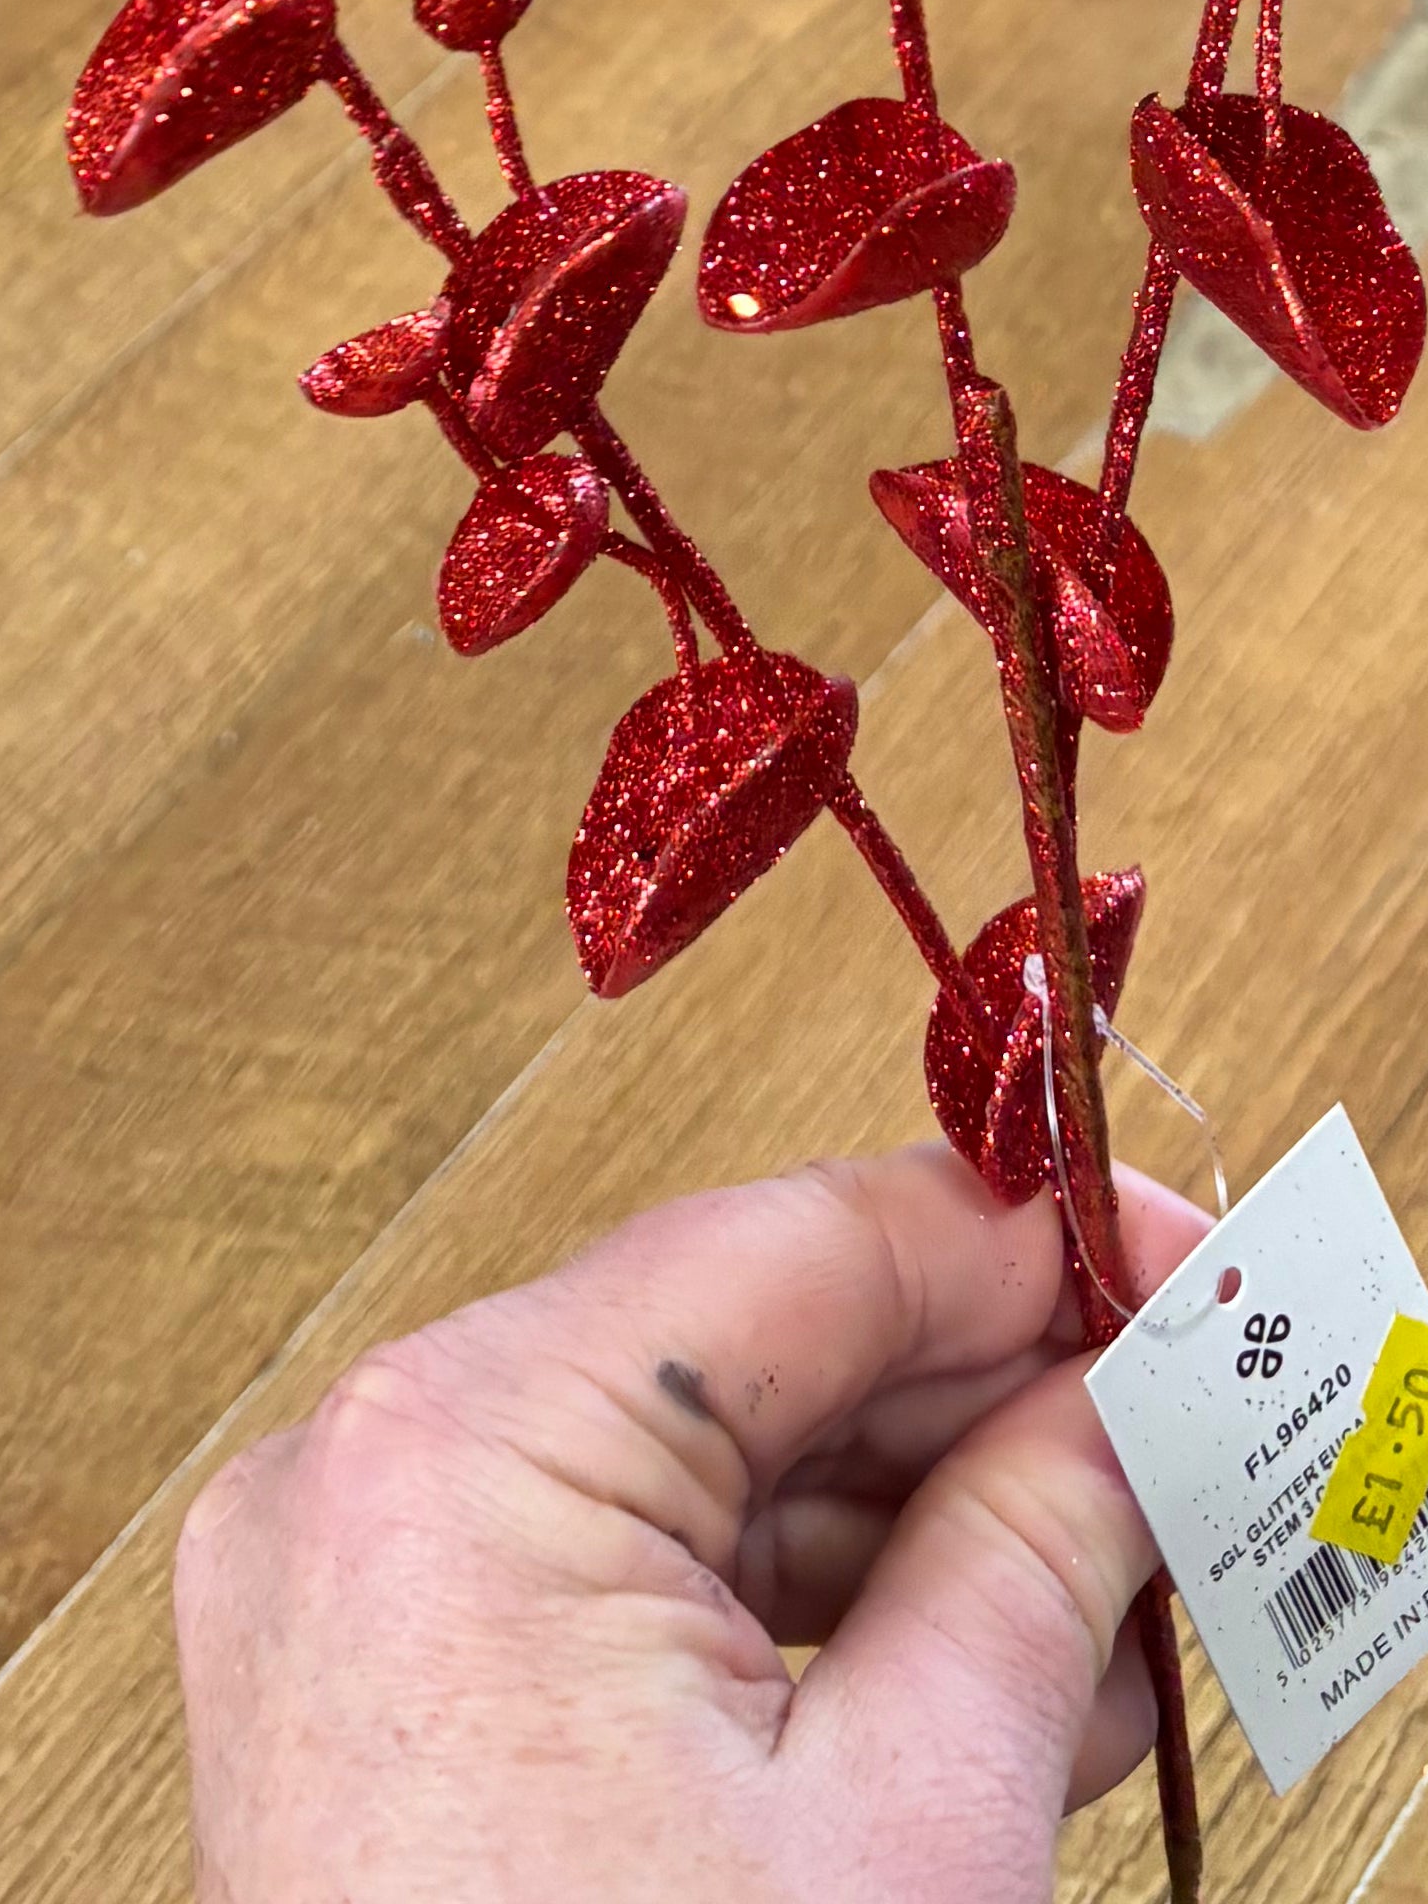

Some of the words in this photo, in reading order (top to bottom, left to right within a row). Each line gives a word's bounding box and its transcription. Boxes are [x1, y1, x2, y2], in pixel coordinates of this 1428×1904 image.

[1244, 1363, 1352, 1482] FL96420
[1209, 1543, 1247, 1582] SGL
[1246, 1463, 1320, 1543] GLITTER
[1253, 1512, 1302, 1567] STEM
[1300, 1500, 1314, 1519] 3
[1276, 1670, 1288, 1688] 5
[1299, 1587, 1372, 1666] 025773
[1320, 1632, 1393, 1712] MADE
[1392, 1604, 1422, 1641] IN
